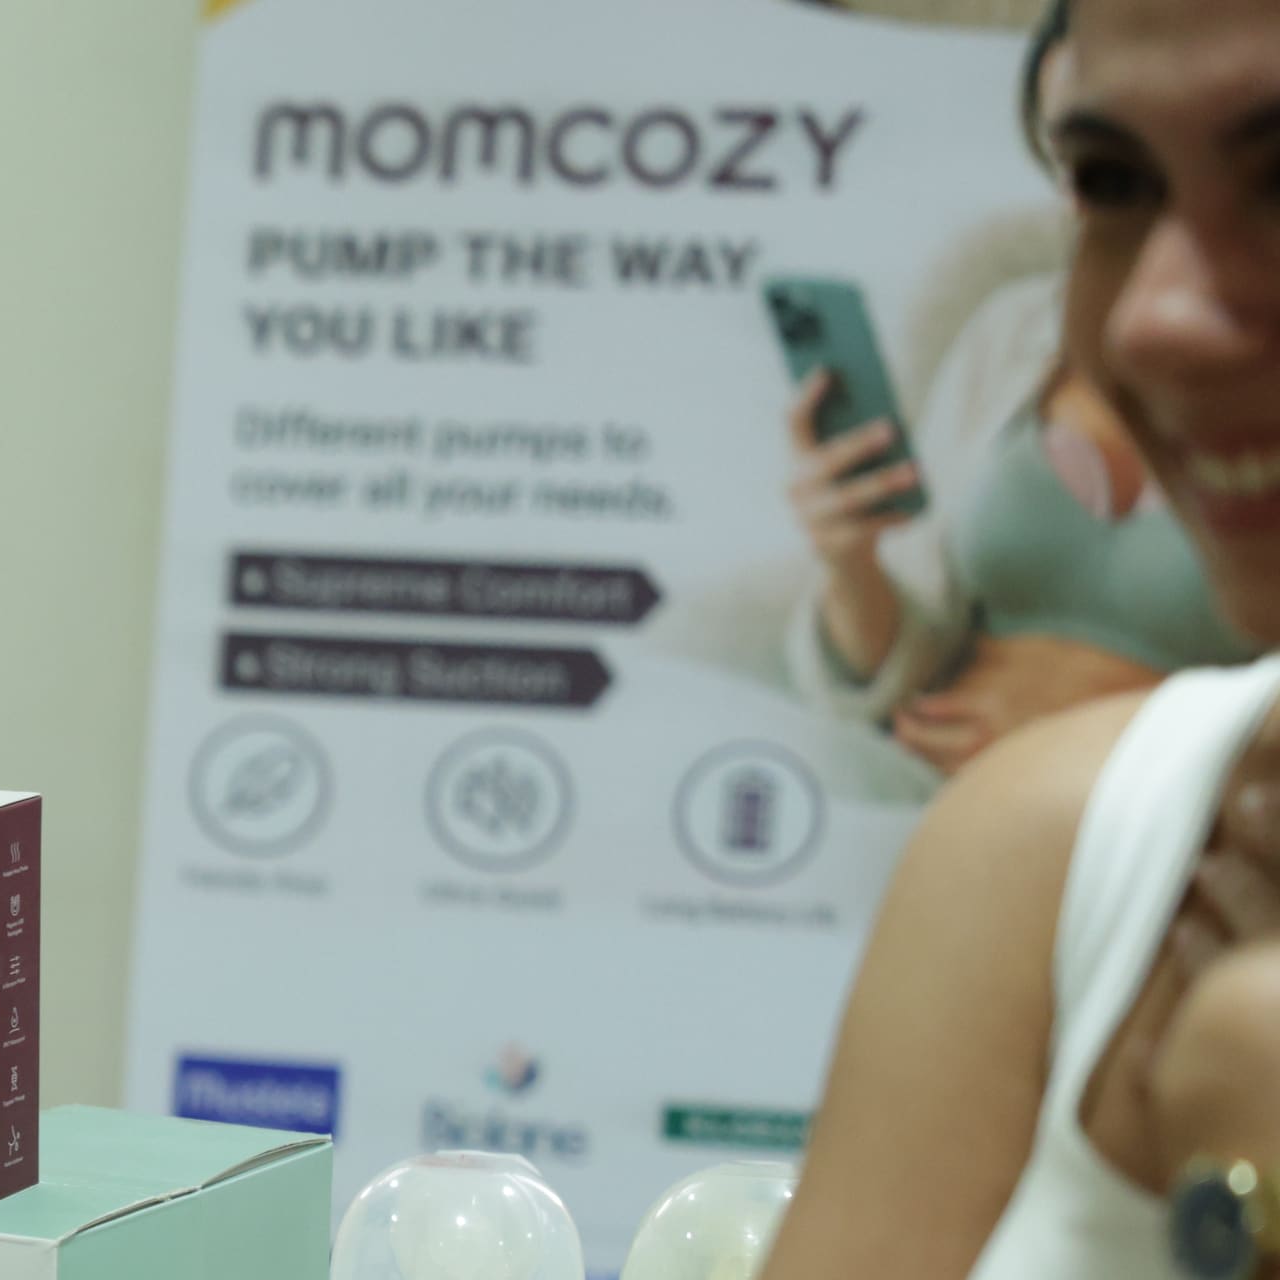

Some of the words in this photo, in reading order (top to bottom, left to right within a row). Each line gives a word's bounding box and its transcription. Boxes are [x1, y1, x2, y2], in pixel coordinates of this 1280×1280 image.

[246, 227, 437, 286] PUMP
[465, 233, 591, 288] THE
[612, 237, 764, 289] WAY
[243, 304, 376, 360] YOU
[391, 307, 535, 364] LIKE
[232, 406, 421, 452] Different
[432, 414, 601, 466] pumps
[610, 419, 651, 457] to
[229, 466, 345, 502] cover
[362, 465, 412, 506] all
[424, 477, 518, 520] your
